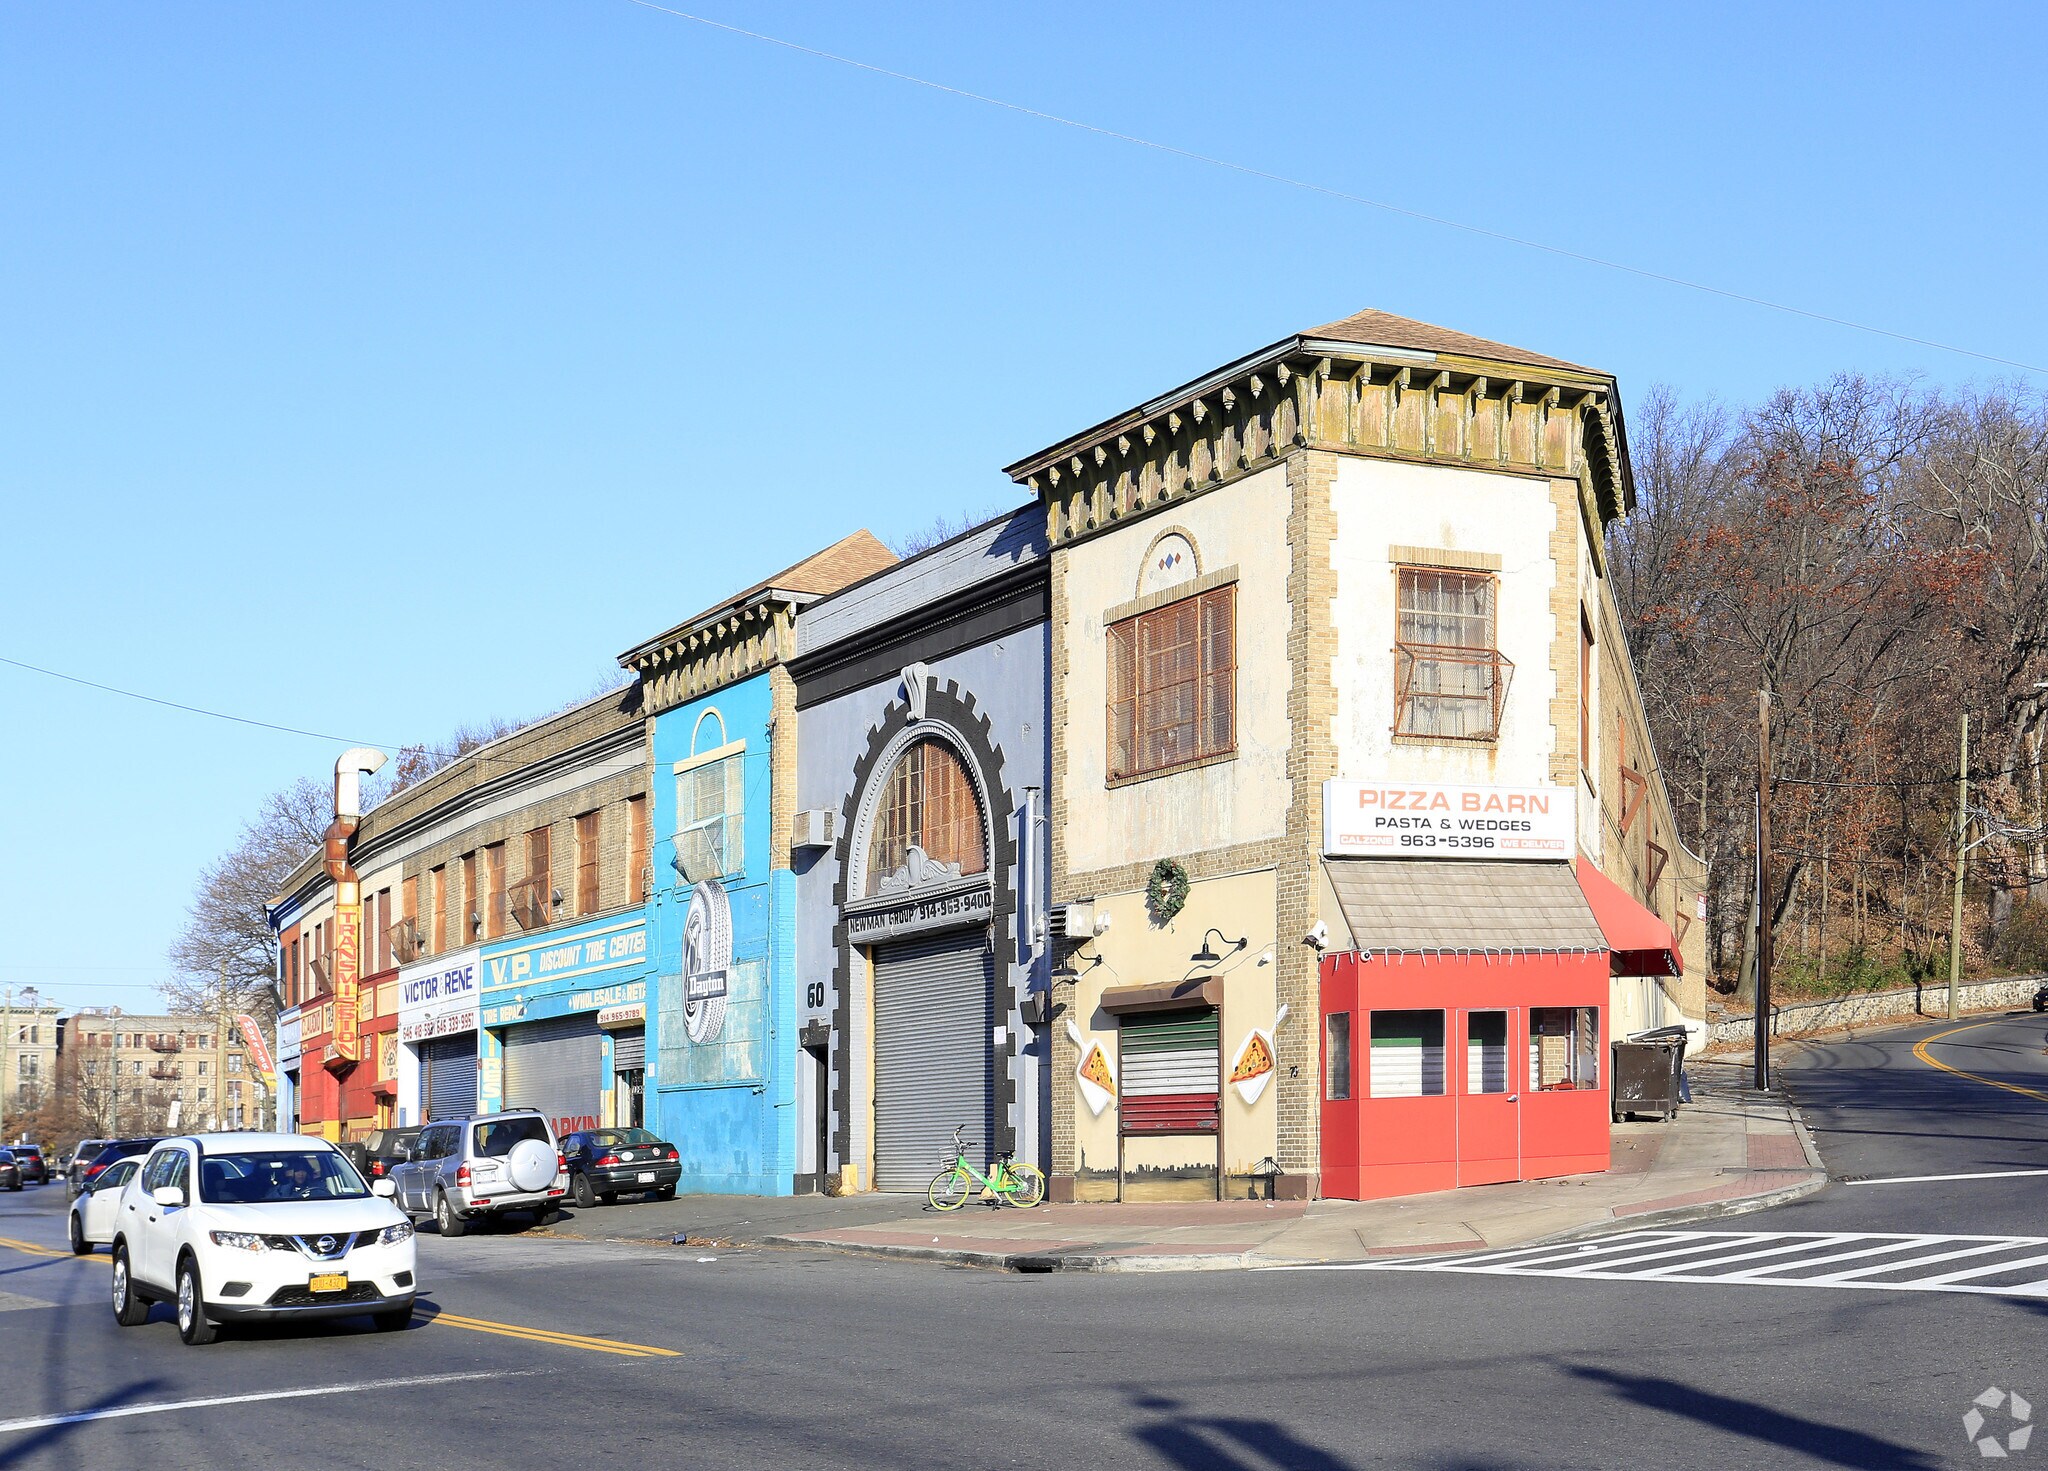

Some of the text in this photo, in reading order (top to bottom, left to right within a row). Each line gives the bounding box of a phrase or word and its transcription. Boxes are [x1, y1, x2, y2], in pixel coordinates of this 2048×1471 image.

[1358, 789, 1549, 814] PIZZA BARN
[1375, 817, 1531, 831] PASTA & WEDGES
[1340, 835, 1393, 845] CALZONE
[1400, 835, 1495, 849] 963-5396
[1501, 839, 1564, 849] WE DELIVER
[850, 915, 886, 934] NEWMAN
[888, 907, 913, 926] GROUP
[539, 944, 582, 973] DISCOUNT
[585, 939, 607, 963] TIRE
[338, 912, 357, 1061] TRANSMISSION
[404, 976, 438, 1004] VICTOR
[444, 966, 473, 995] RENE
[572, 985, 621, 1010] WHOLESALE
[689, 977, 725, 997] Dayton
[807, 981, 825, 1009] 60
